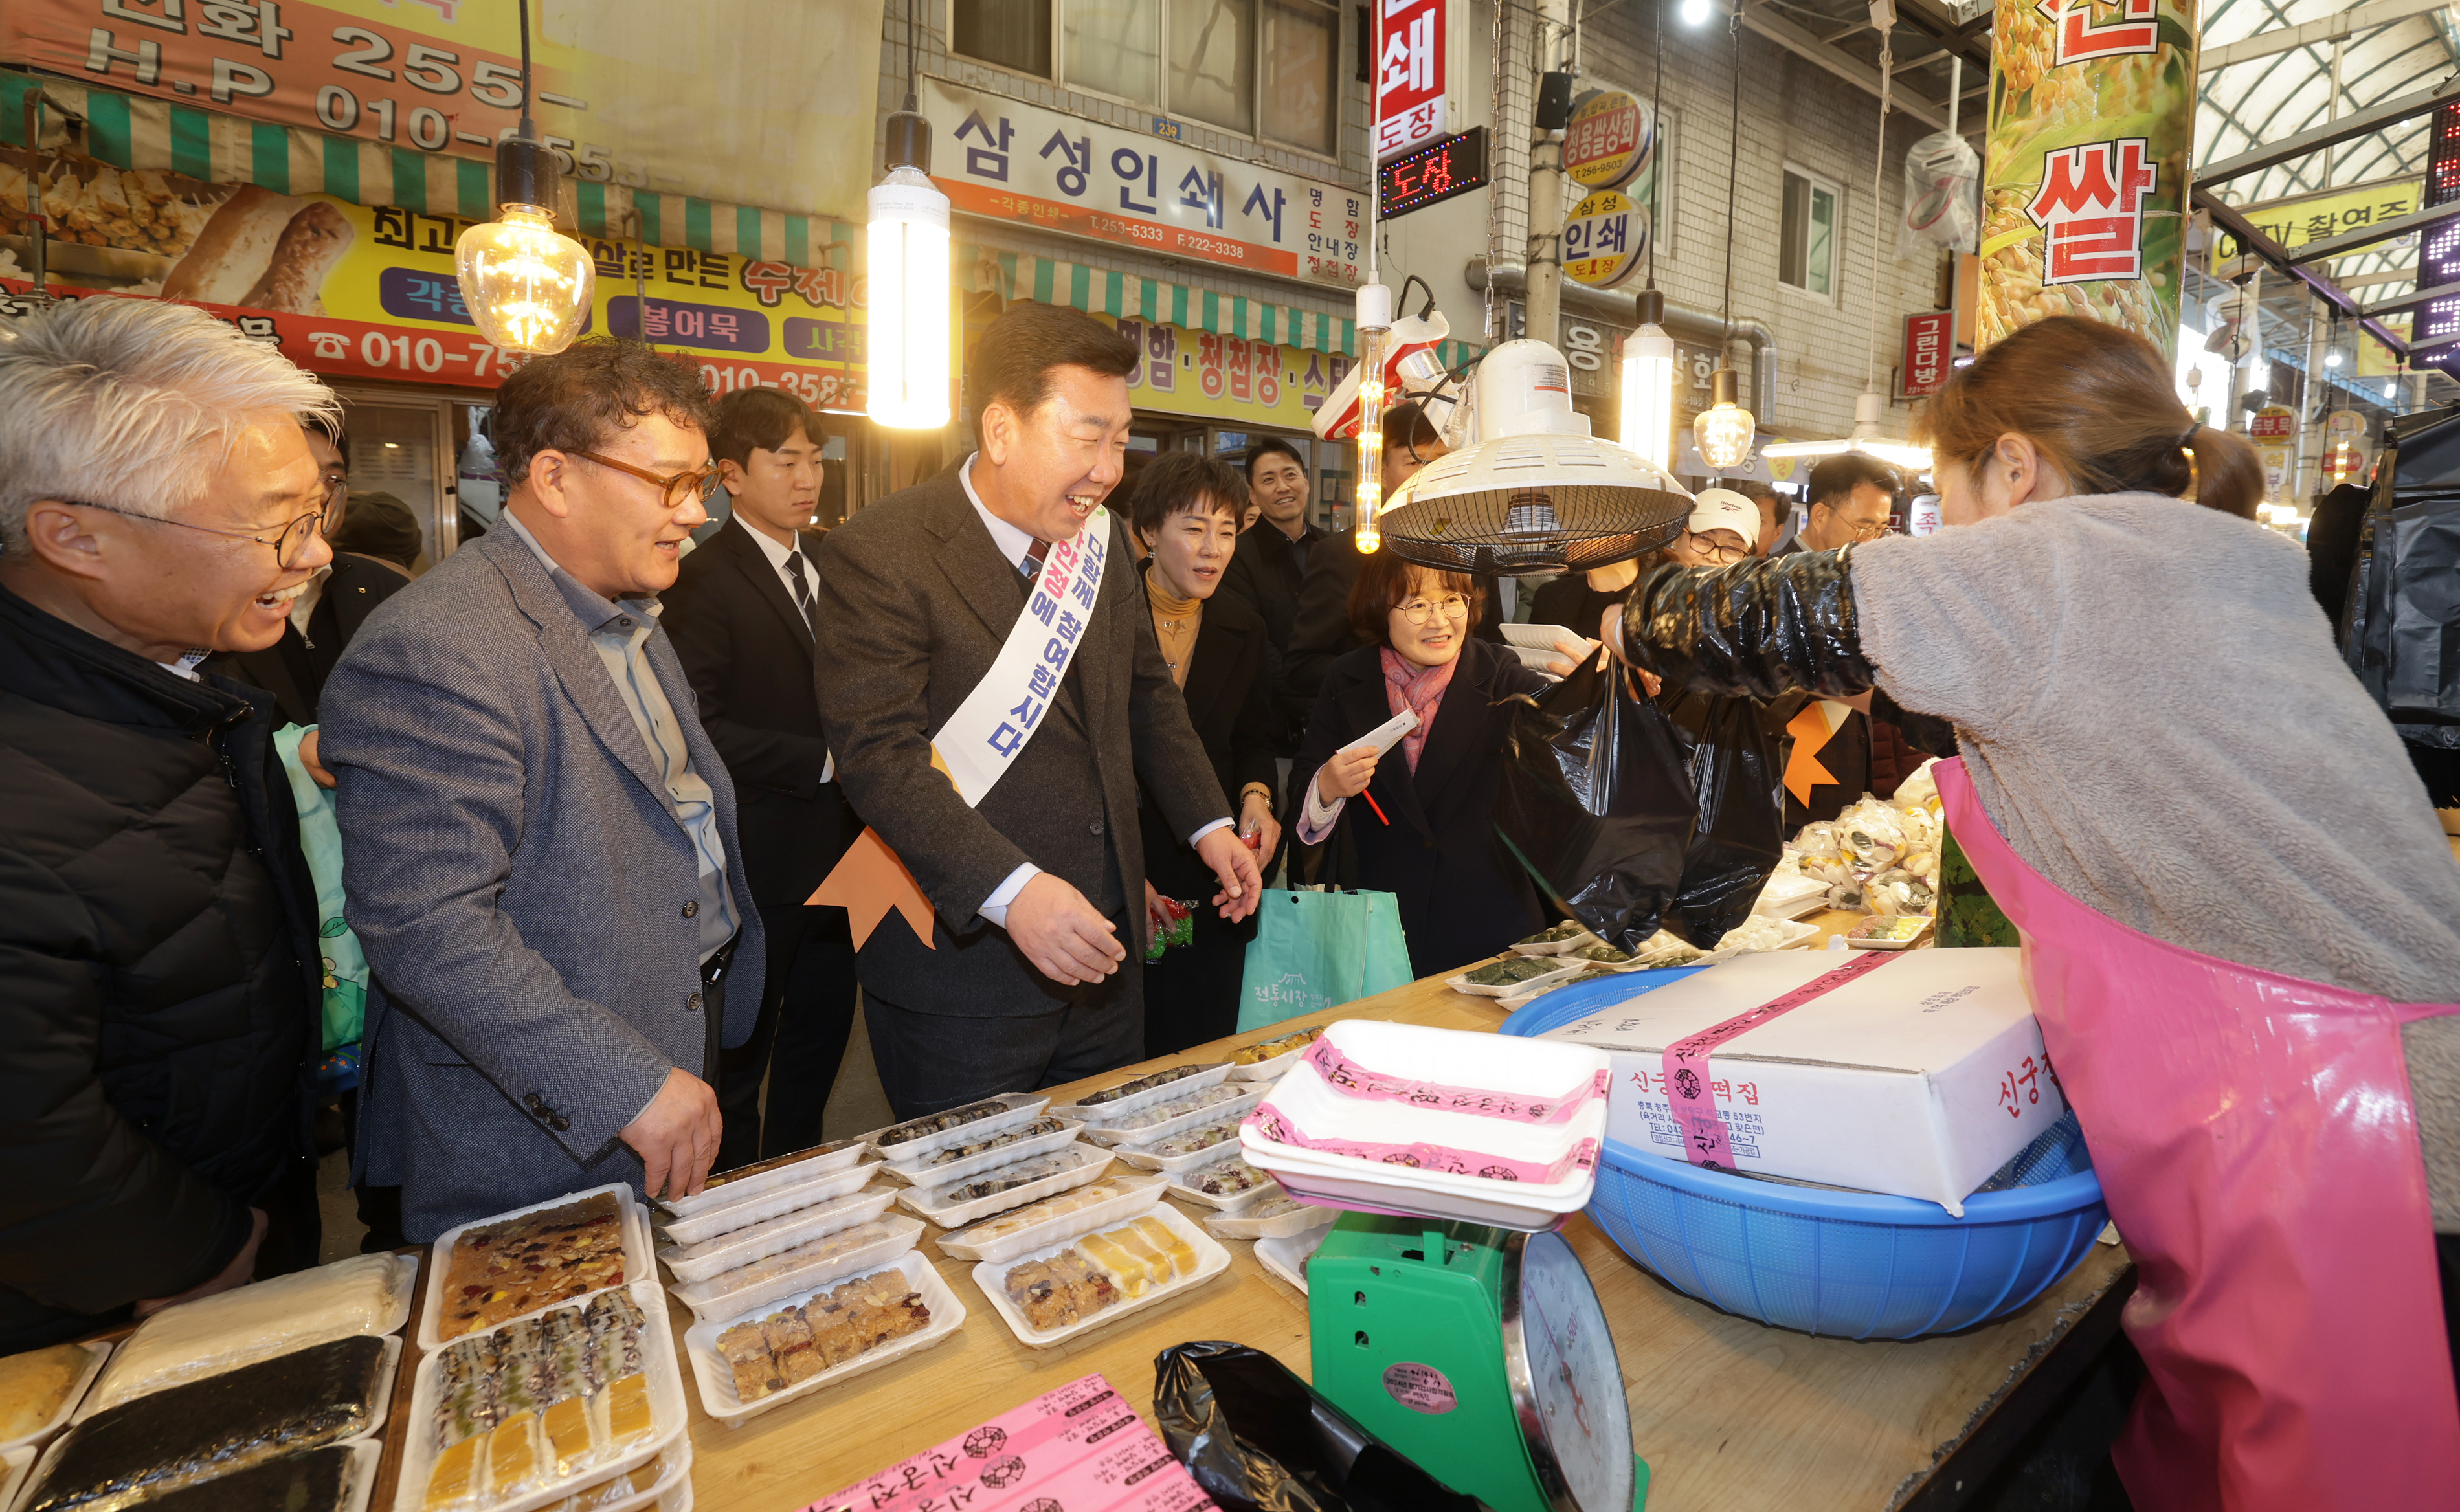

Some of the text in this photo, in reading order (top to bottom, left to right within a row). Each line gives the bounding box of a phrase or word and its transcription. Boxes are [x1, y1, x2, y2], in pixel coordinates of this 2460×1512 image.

[1377, 102, 1436, 154] 도장
[953, 108, 1287, 244] 삼성인쇄사
[1391, 150, 1452, 201] 도장
[1580, 195, 1617, 216] 삼성
[2025, 138, 2158, 286] 쌀
[1308, 233, 1359, 261] 안내장
[1565, 214, 1629, 261] 인쇄
[665, 249, 730, 291] 만든
[1306, 255, 1358, 283] 청첩장
[643, 304, 740, 343] 불어묵
[1198, 332, 1283, 407] 청첩장
[1914, 318, 1940, 384] 그린다방
[1720, 500, 1743, 511] Reebok
[987, 532, 1104, 759] 다함께 참여합시다
[1255, 983, 1308, 1008] 전통시장
[1733, 1111, 1763, 1124] 53번지
